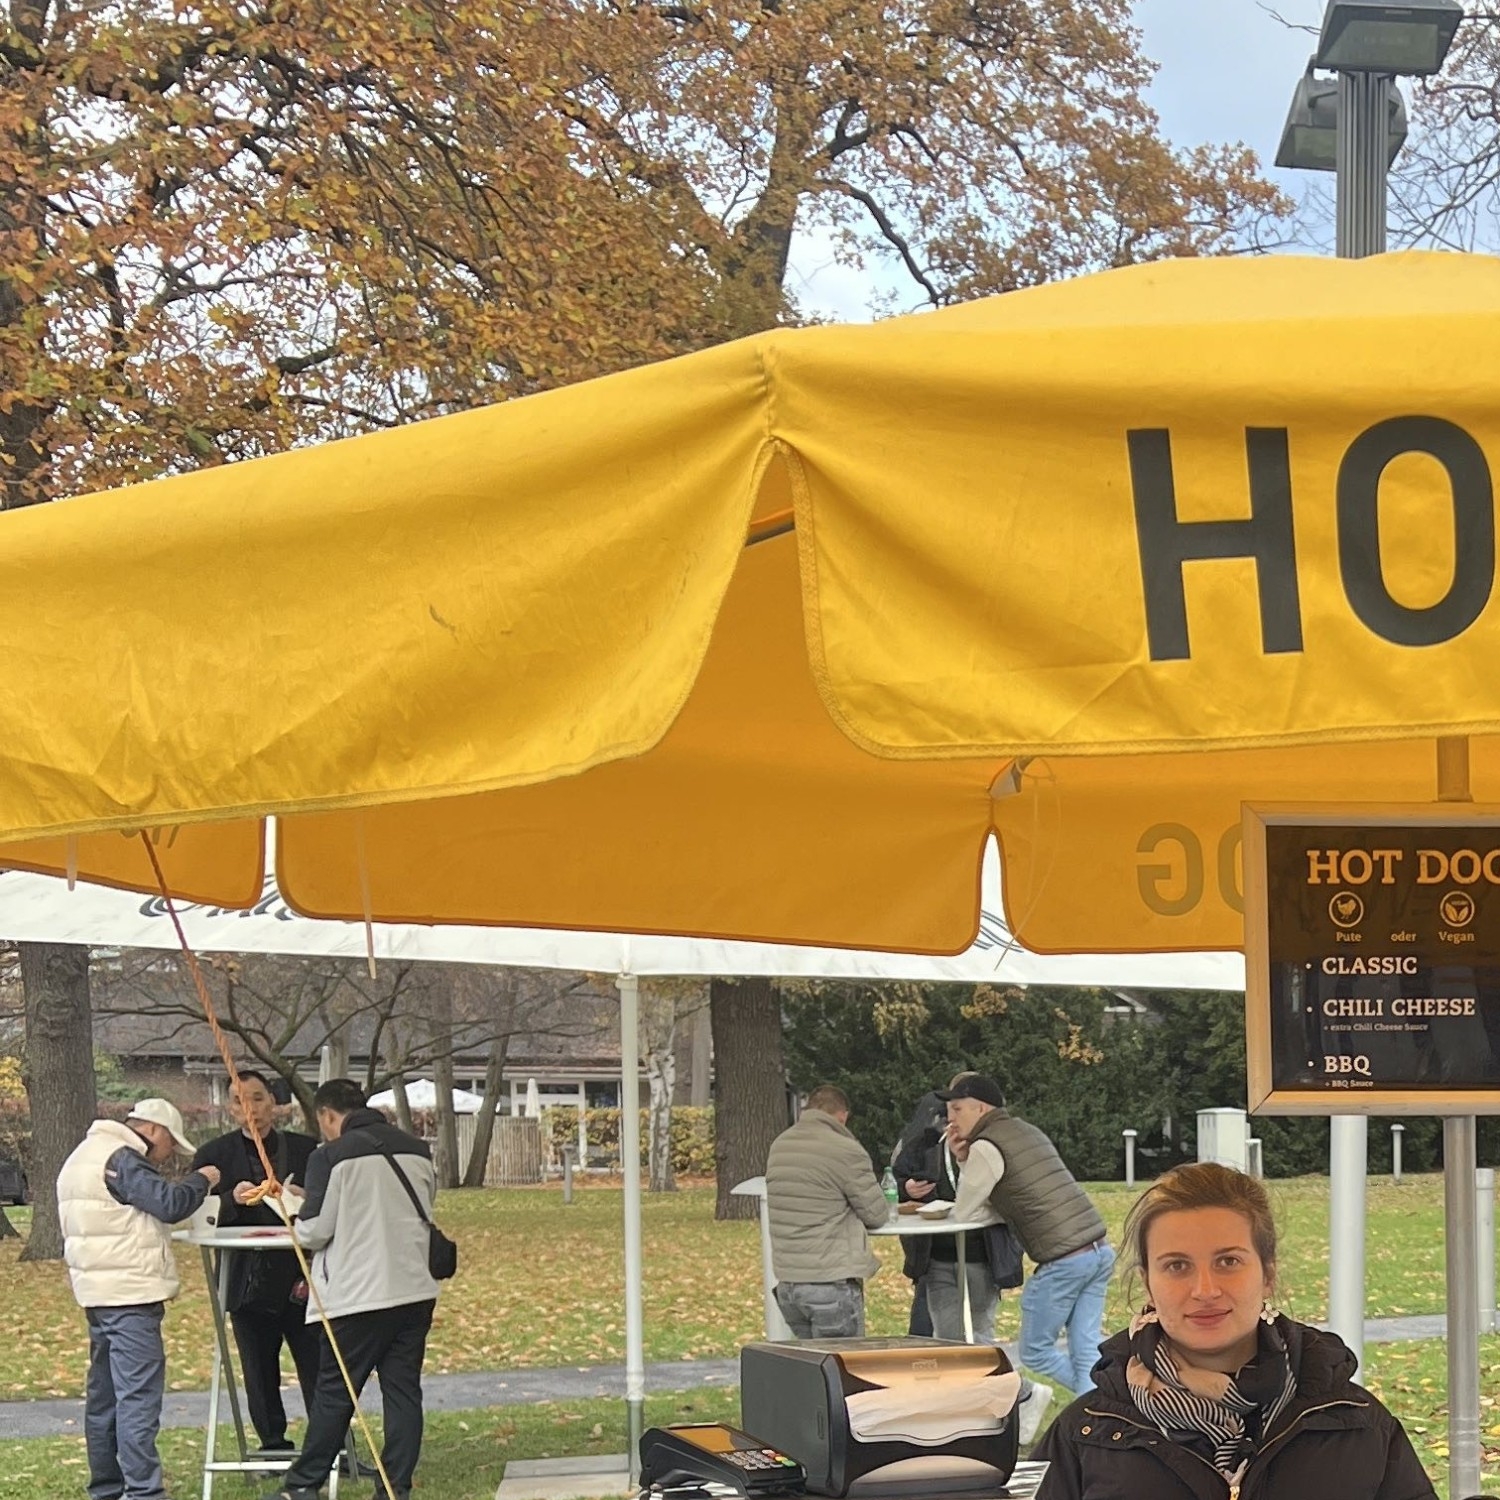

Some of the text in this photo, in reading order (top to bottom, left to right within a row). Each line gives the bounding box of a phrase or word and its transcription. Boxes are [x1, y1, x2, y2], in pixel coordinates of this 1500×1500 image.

[1306, 849, 1403, 885] HOT
[1335, 931, 1475, 945] Pute oder Vegan
[1321, 956, 1418, 975] CLASSIC
[1322, 999, 1384, 1017] CHILI
[1391, 998, 1476, 1016] CHEESE
[1353, 1023, 1373, 1031] Chili
[1374, 1023, 1403, 1031] Cheese
[1404, 1023, 1428, 1031] Sauce
[1324, 1055, 1372, 1076] BBQ
[1331, 1080, 1349, 1088] BBQ
